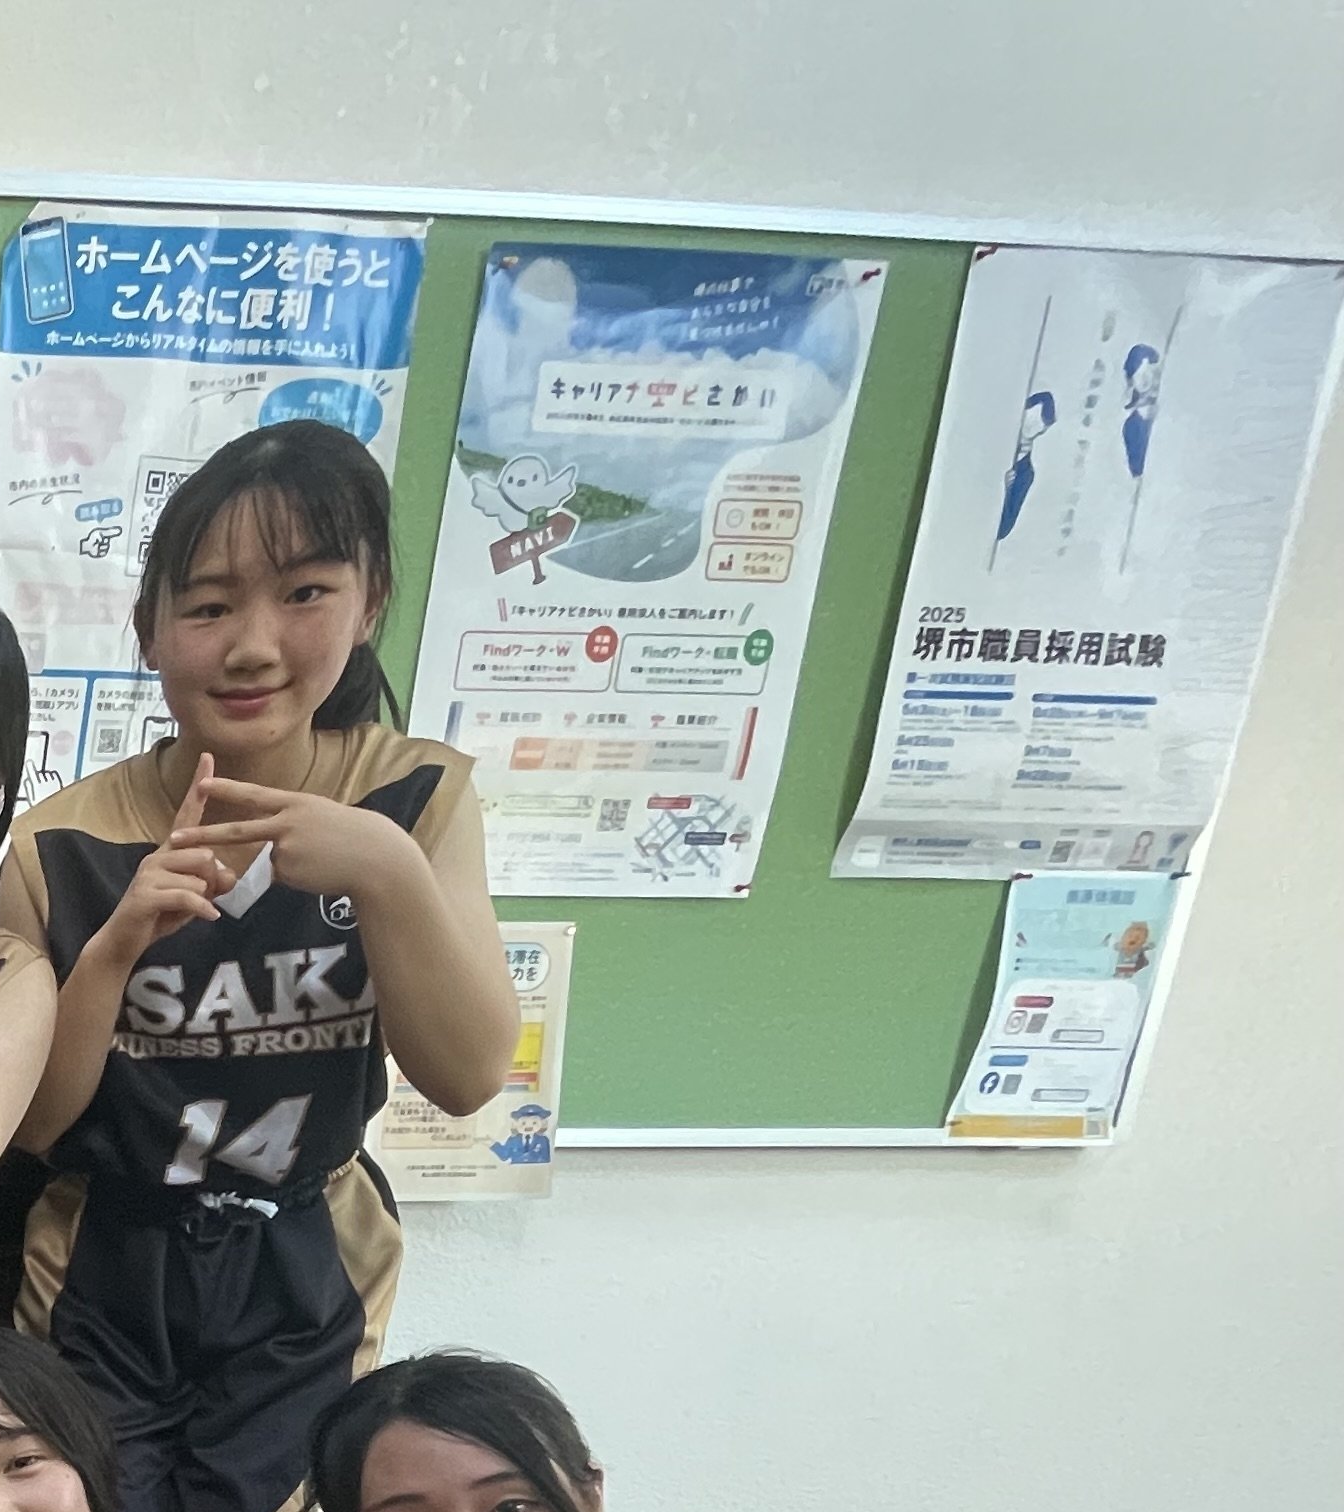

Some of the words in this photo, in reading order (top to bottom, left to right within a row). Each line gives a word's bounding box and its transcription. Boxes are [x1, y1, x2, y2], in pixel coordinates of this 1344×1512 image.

[76, 234, 391, 288] ホームページを使うと
[111, 283, 336, 331] こんなに便利！
[510, 525, 555, 559] NAVI
[918, 606, 966, 623] 2025
[912, 626, 1166, 668] 堺市職員採用試験
[125, 943, 377, 1036] SAK
[229, 1013, 375, 1057] FRONT
[163, 1093, 313, 1187] 14
